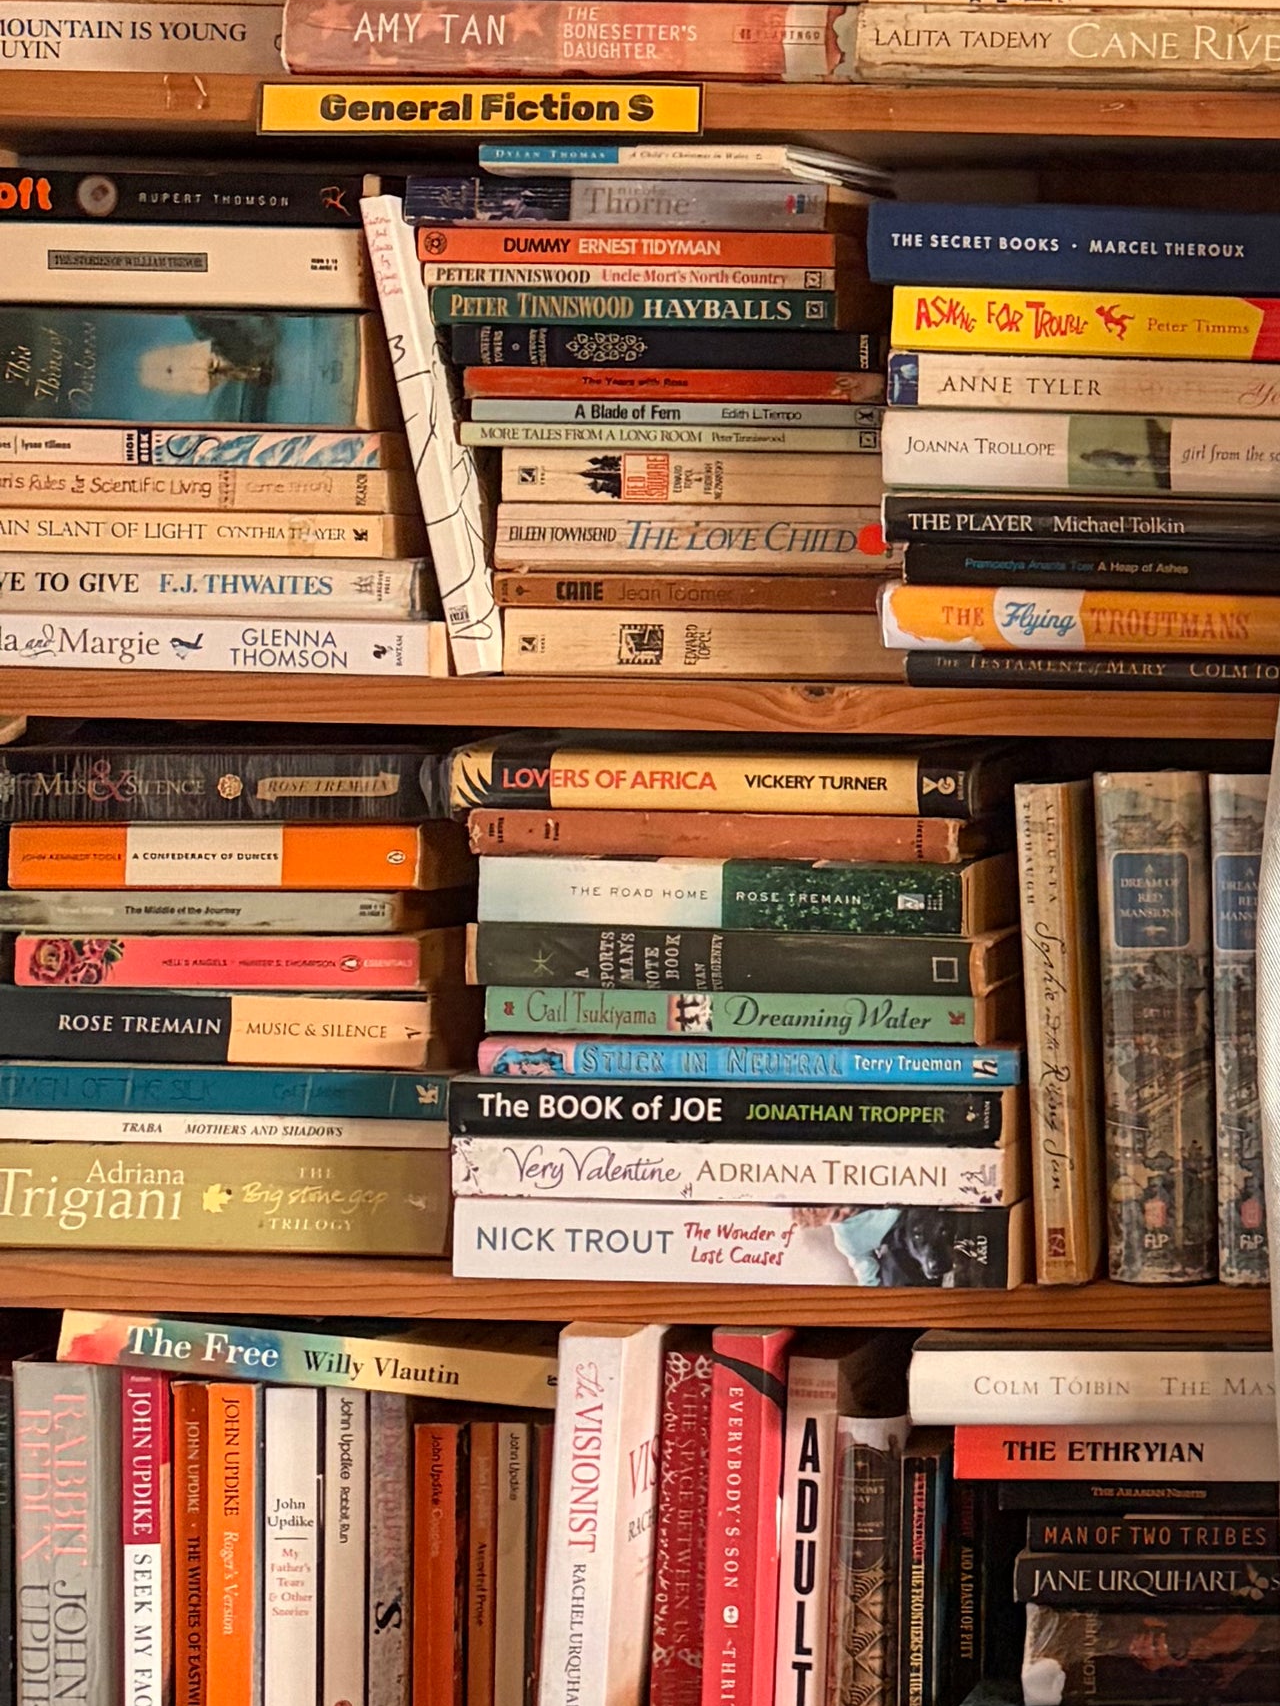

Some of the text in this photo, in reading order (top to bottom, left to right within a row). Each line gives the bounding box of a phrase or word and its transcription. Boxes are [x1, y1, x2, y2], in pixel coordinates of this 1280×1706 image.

[321, 94, 654, 123] General Fiction S
[891, 234, 1245, 258] THE SECRET BOOKS MARCEL THEROUX
[643, 297, 791, 321] HAYBALLS
[240, 628, 336, 650] GLENNA
[230, 645, 348, 670] THOMSON
[477, 1226, 673, 1254] NICK TROUT
[126, 1327, 460, 1386] The Free Willy Vlautin
[1003, 1440, 1204, 1463] THE ETHRYIAN
[569, 1404, 604, 1554] VISIONIST
[1033, 1568, 1240, 1595] JANE URQUHART
